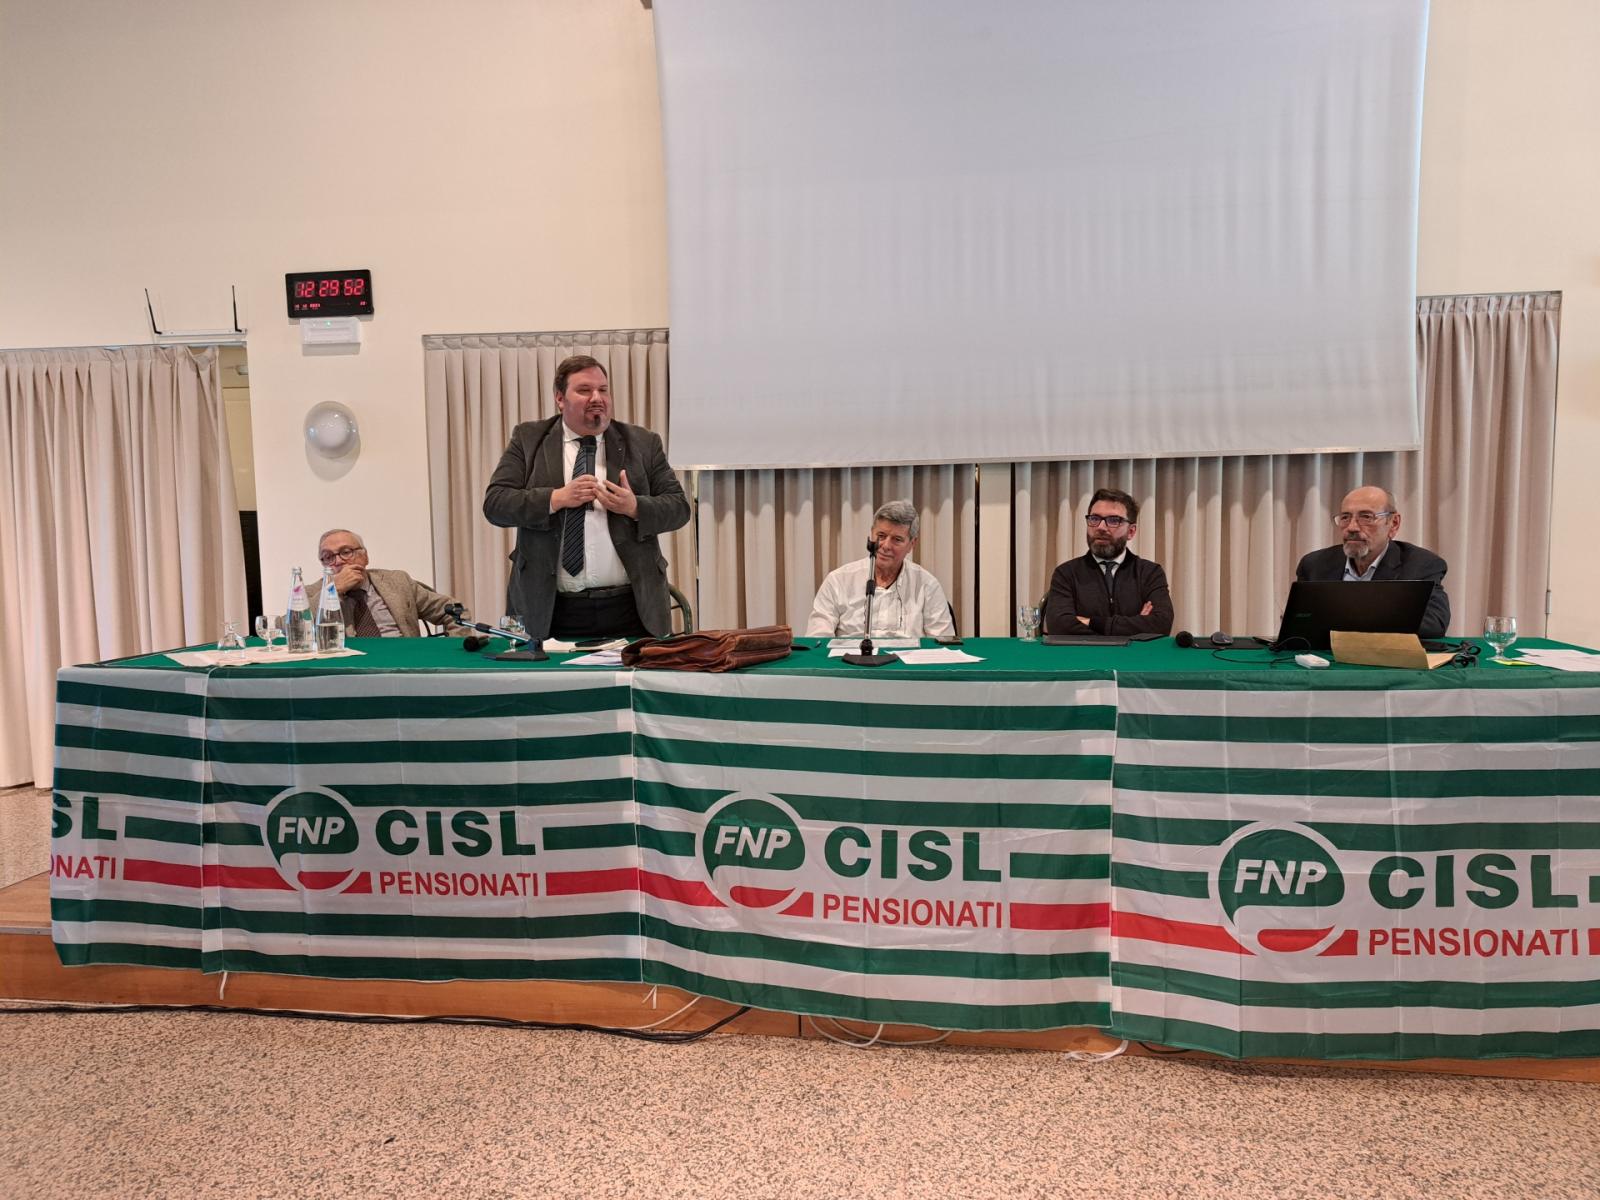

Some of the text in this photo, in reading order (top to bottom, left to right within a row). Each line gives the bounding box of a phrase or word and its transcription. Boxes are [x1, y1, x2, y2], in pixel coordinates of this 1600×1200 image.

[296, 279, 364, 298] 12 29 52
[278, 808, 537, 857] FNP CISL
[50, 854, 116, 880] NATI
[714, 825, 1002, 883] FNP CISL
[379, 871, 539, 897] PENSIONATI
[1234, 853, 1579, 910] FNP CISL
[822, 893, 1002, 929] PENSIONATI
[1369, 927, 1579, 958] PENSIONATI
